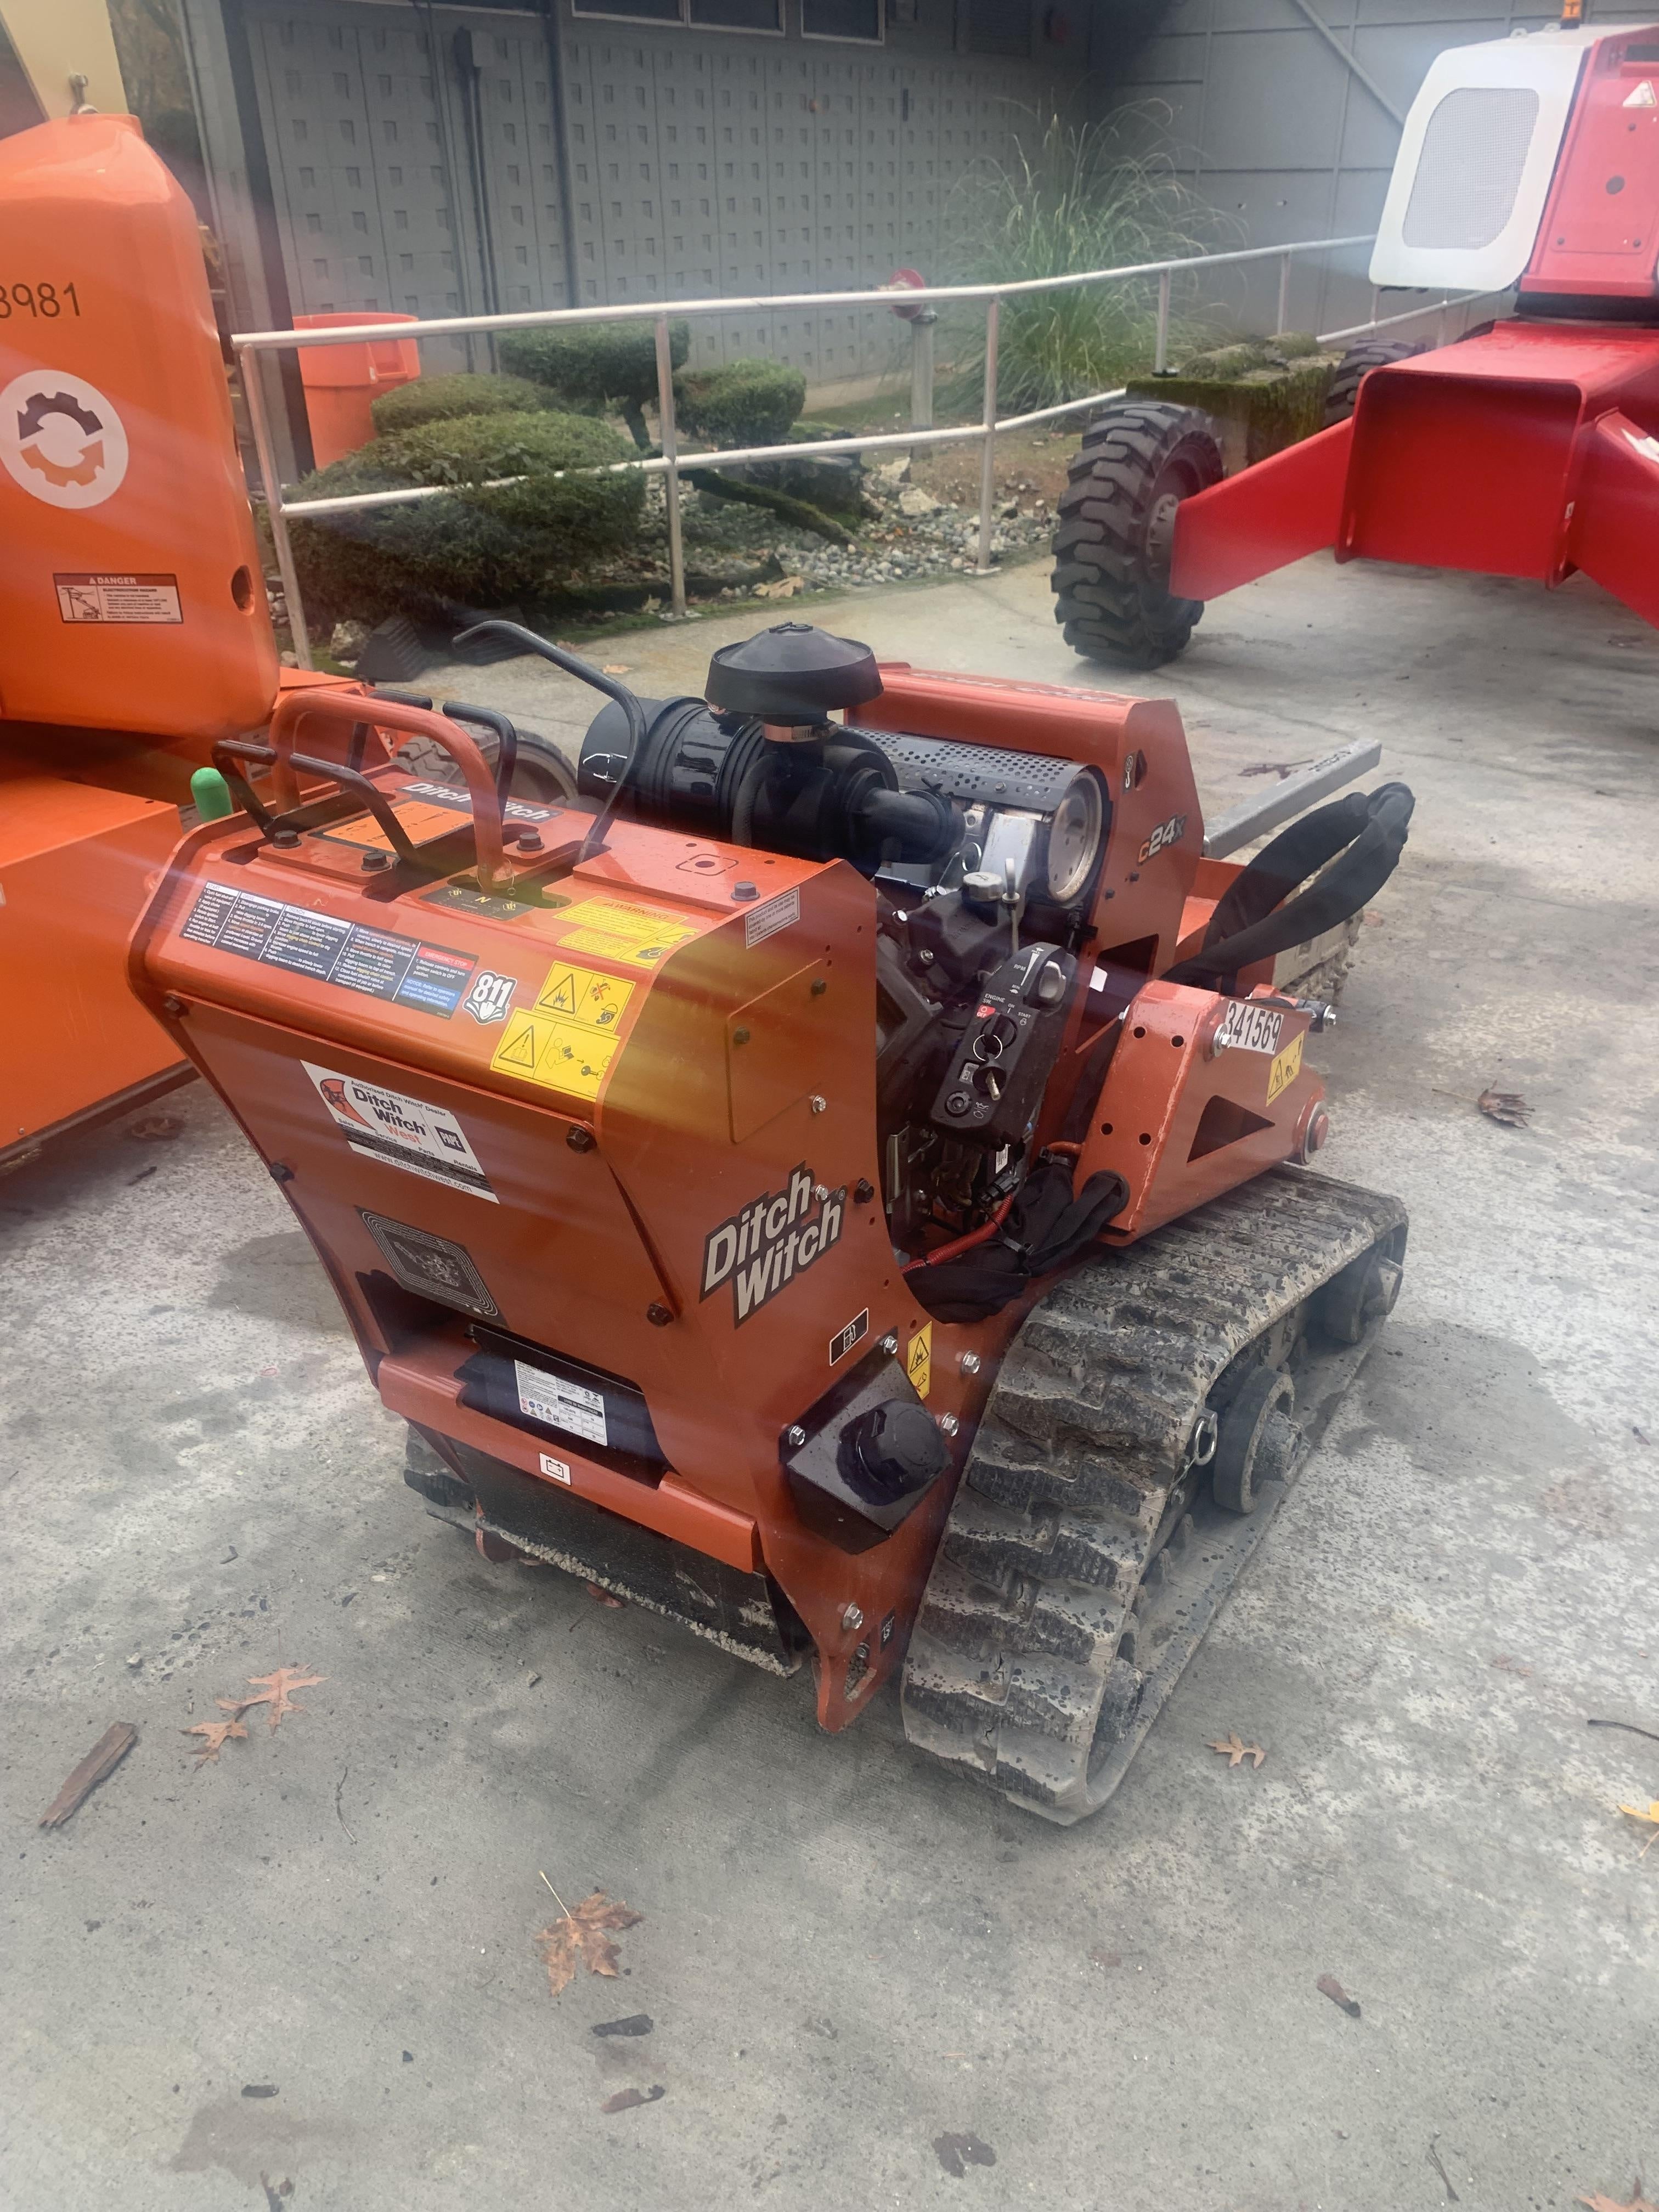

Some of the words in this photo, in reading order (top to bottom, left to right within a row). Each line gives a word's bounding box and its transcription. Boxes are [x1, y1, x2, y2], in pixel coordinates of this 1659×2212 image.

[401, 782, 472, 803] Ditch
[614, 905, 669, 920] WARNING
[473, 974, 513, 1008] 811
[984, 994, 1006, 1003] ENGINE
[1228, 1002, 1282, 1051] 341569
[351, 1081, 385, 1096] Authorized
[386, 1092, 403, 1103] Ditch
[425, 1105, 447, 1116] Dealer
[352, 1087, 403, 1115] Ditch
[372, 1107, 426, 1136] Witch
[384, 1125, 422, 1145] West
[338, 1118, 354, 1127] Sales
[375, 1131, 397, 1143] Service
[418, 1147, 435, 1156] Parts
[453, 1159, 478, 1172] Rentals
[374, 1152, 472, 1193] www.ditchwitchwest.com
[704, 1171, 811, 1292] Ditch
[737, 1199, 841, 1319] Witch
